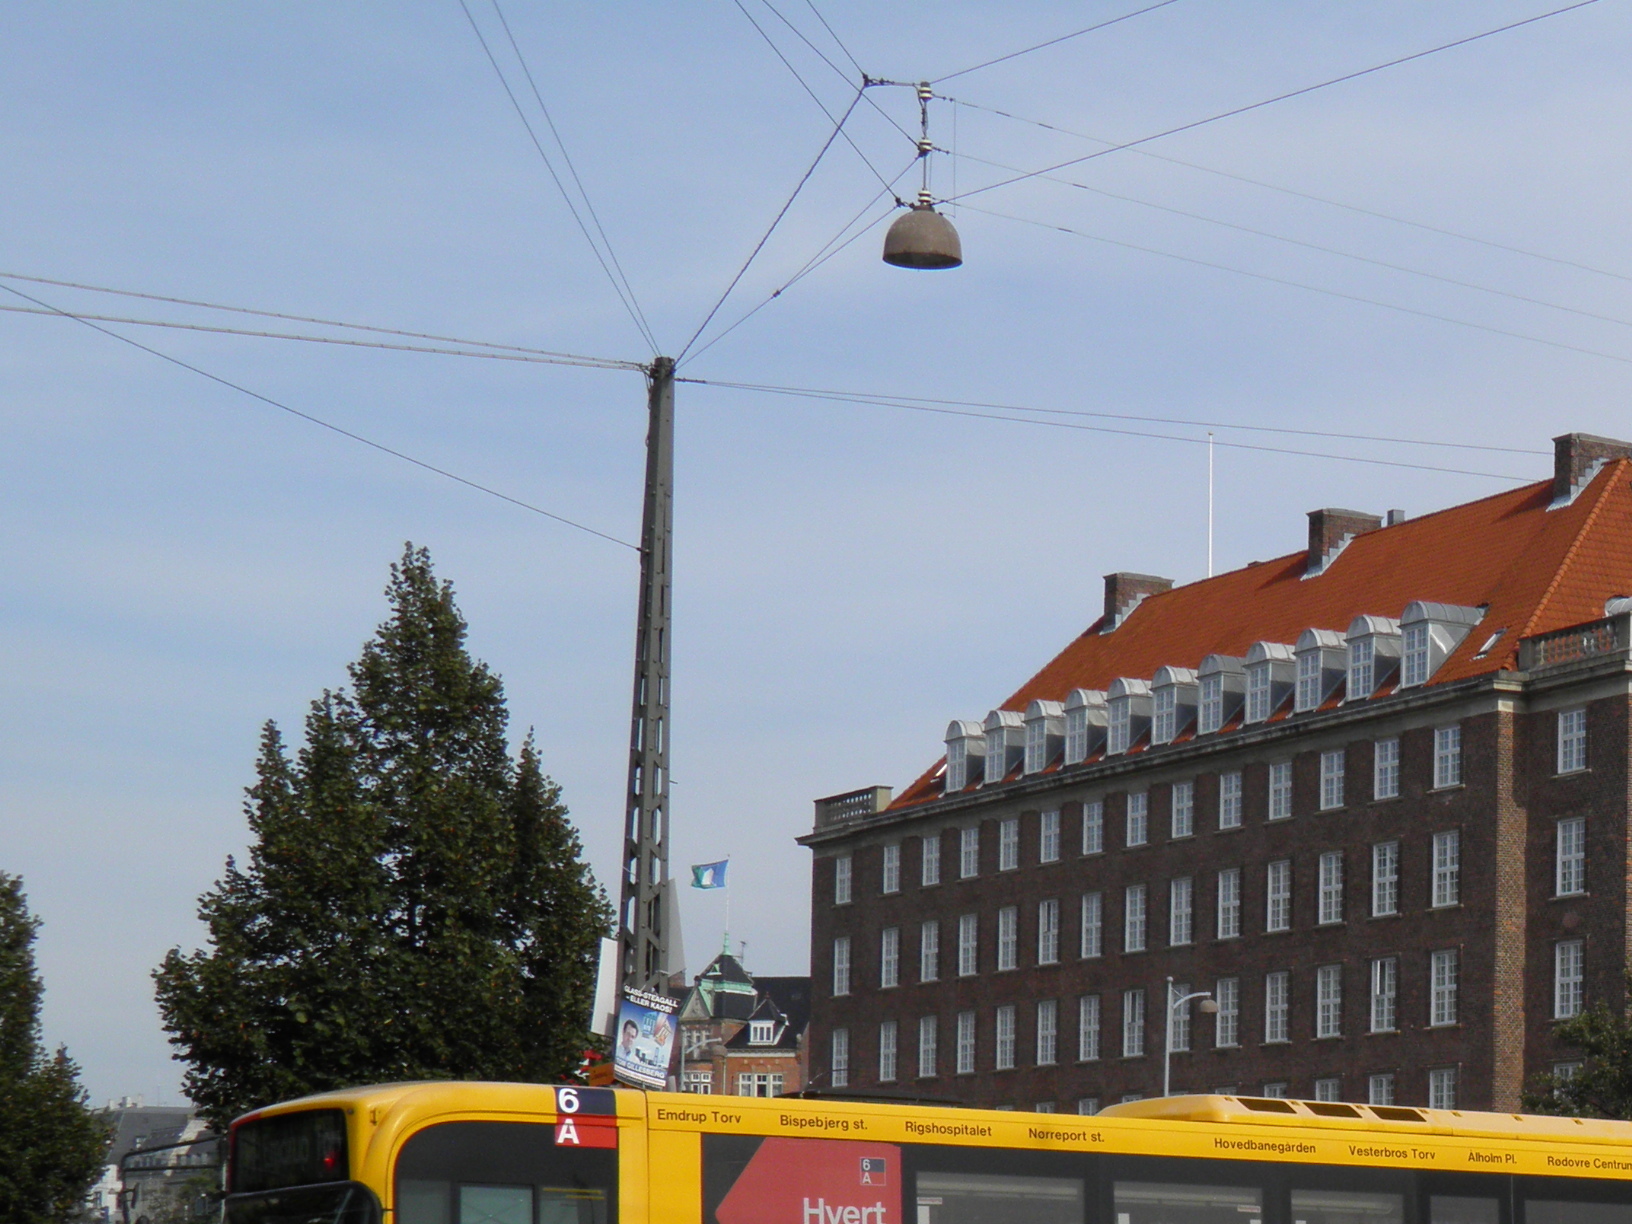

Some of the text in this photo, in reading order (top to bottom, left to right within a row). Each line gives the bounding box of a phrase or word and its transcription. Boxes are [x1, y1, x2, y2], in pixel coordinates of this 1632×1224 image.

[630, 994, 650, 1007] ELLER
[558, 1088, 580, 1113] 6
[657, 1109, 741, 1124] Emdrup Torv
[780, 1115, 868, 1132] Bispebjerg st.
[557, 1118, 580, 1145] A
[905, 1121, 992, 1137] Rigshospitalet
[1028, 1127, 1105, 1143] Nørreport st.
[1214, 1137, 1316, 1154] Hovedbanegården
[1349, 1145, 1436, 1160] Vesterbros Torv
[1468, 1150, 1517, 1164] Ålholm Pl.
[1547, 1156, 1591, 1169] Rødovre
[862, 1159, 871, 1171] 6
[862, 1172, 872, 1184] A
